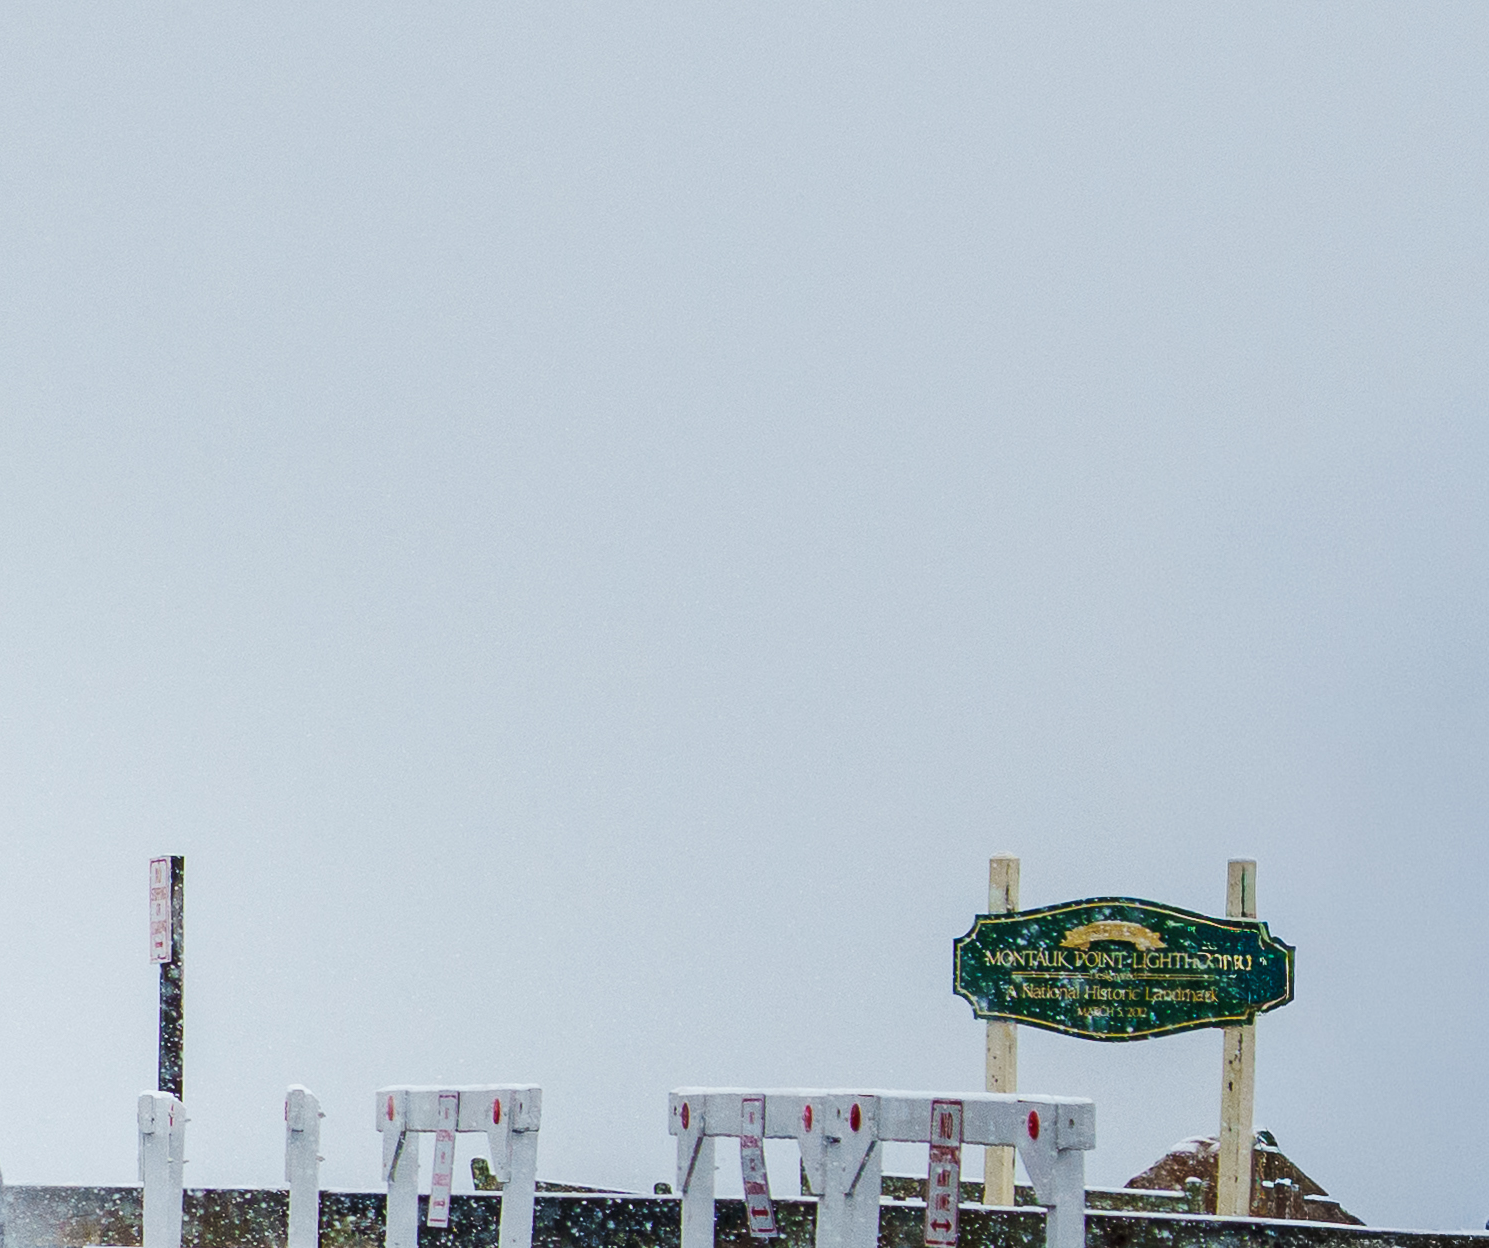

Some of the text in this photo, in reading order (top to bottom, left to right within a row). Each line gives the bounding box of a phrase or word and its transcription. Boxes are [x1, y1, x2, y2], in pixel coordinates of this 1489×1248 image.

[986, 950, 1252, 971] MONTAUK POINT LIGHTH
[1023, 983, 1080, 1000] National
[1085, 985, 1141, 1001] Historic
[1145, 986, 1219, 1003] Landmark
